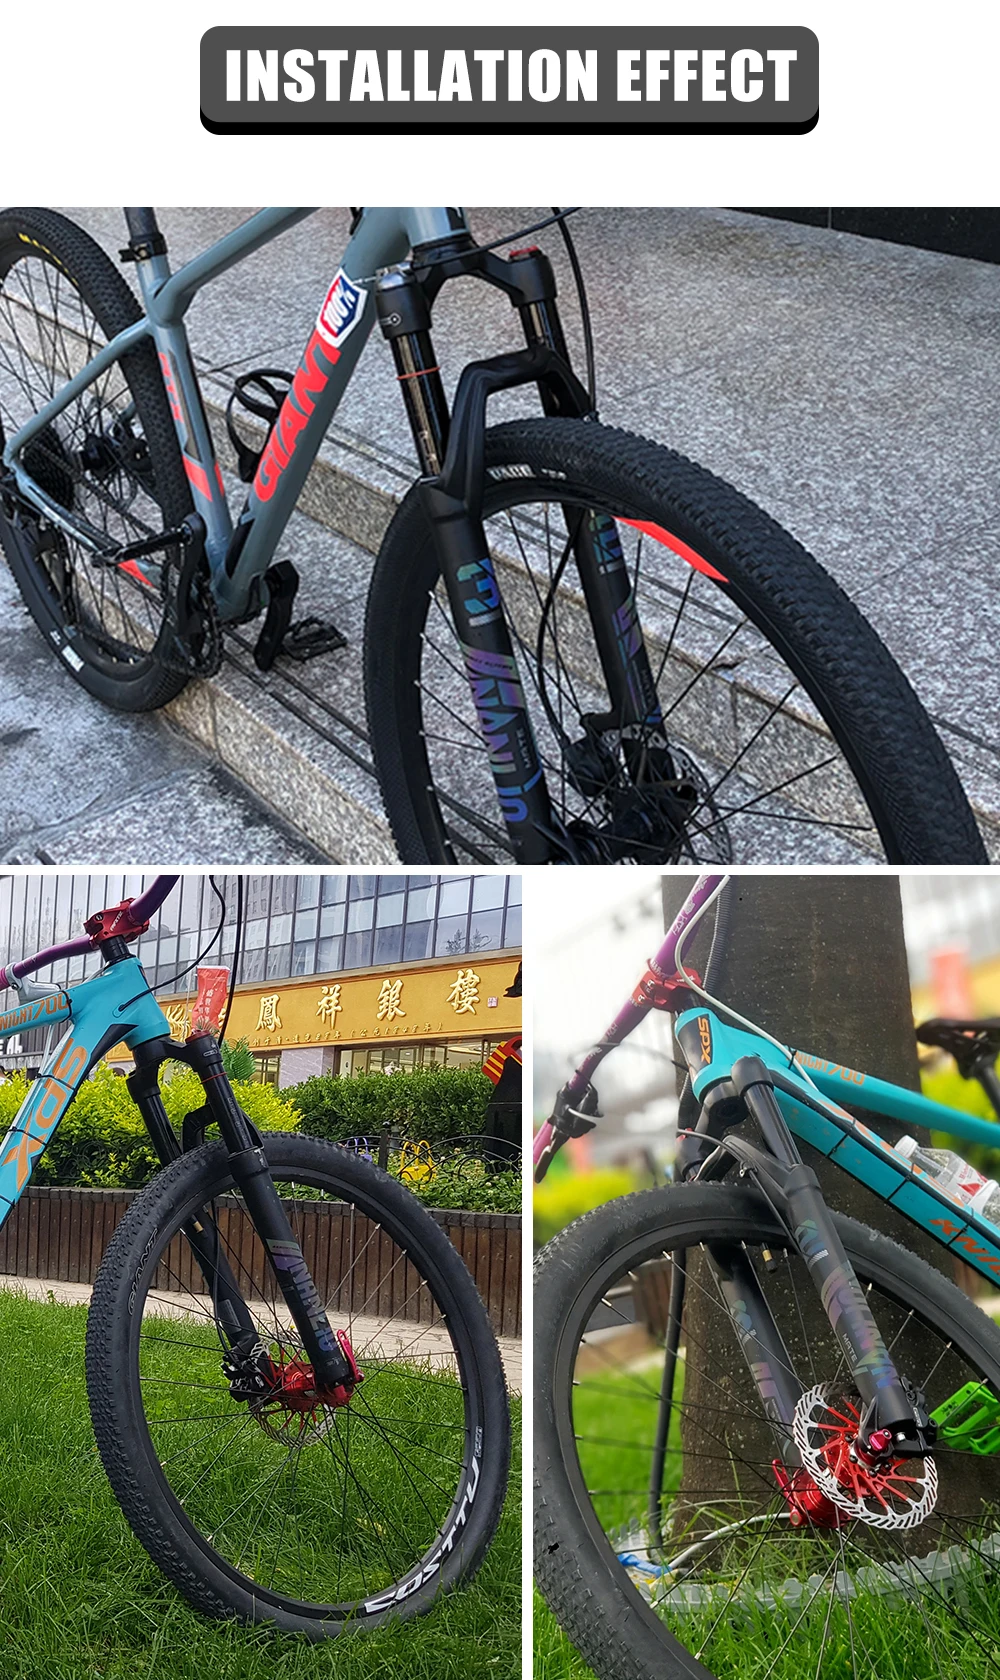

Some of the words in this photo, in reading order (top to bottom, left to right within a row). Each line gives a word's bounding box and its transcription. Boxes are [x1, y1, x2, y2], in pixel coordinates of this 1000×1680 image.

[322, 280, 356, 334] 100%
[253, 328, 342, 503] GIANT
[217, 968, 481, 1032] 鳳祥銀樓
[842, 1332, 858, 1363] MATE
